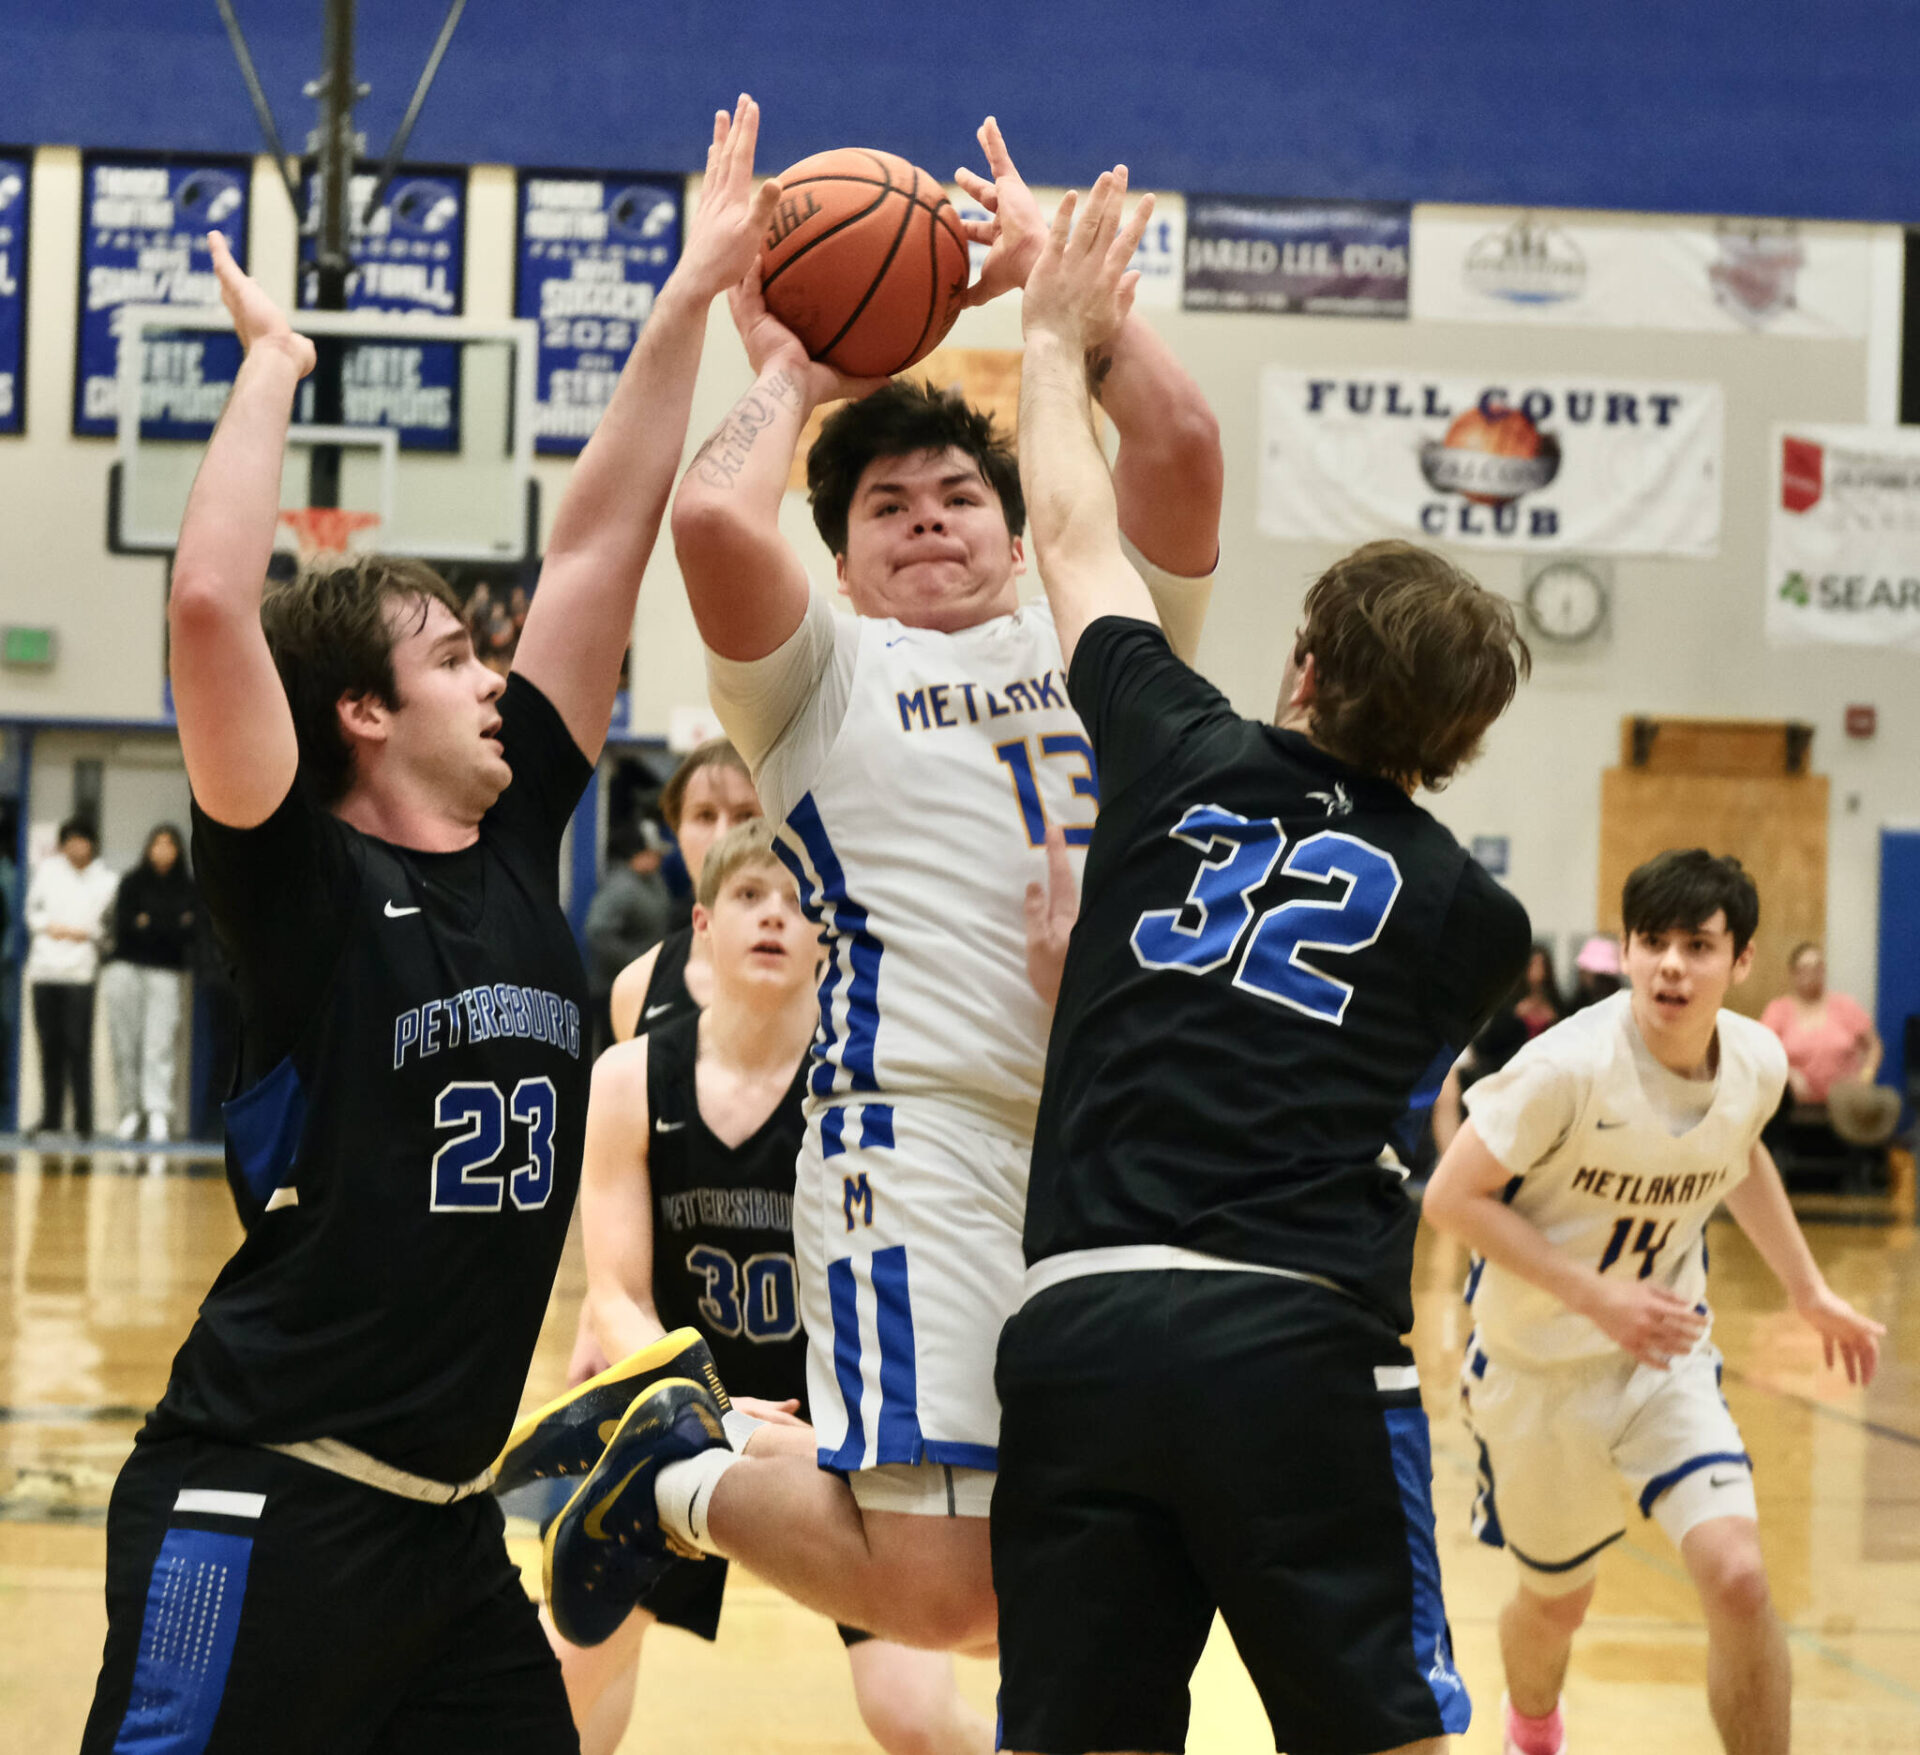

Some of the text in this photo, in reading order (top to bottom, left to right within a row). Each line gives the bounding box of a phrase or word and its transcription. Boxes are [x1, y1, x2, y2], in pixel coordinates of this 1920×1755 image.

[1304, 378, 1682, 428] FULL COURT
[1420, 502, 1561, 537] CLUB
[895, 668, 1067, 733] METLAK
[991, 729, 1100, 849] 13
[1129, 803, 1403, 1026] 32
[393, 982, 580, 1071] PETERSBURG
[429, 1075, 557, 1213] 23
[660, 1188, 795, 1232] ETERSBU
[842, 1171, 873, 1234] M
[1570, 1165, 1728, 1206] METLAKAT
[1598, 1216, 1679, 1283] 14
[685, 1243, 800, 1344] 30
